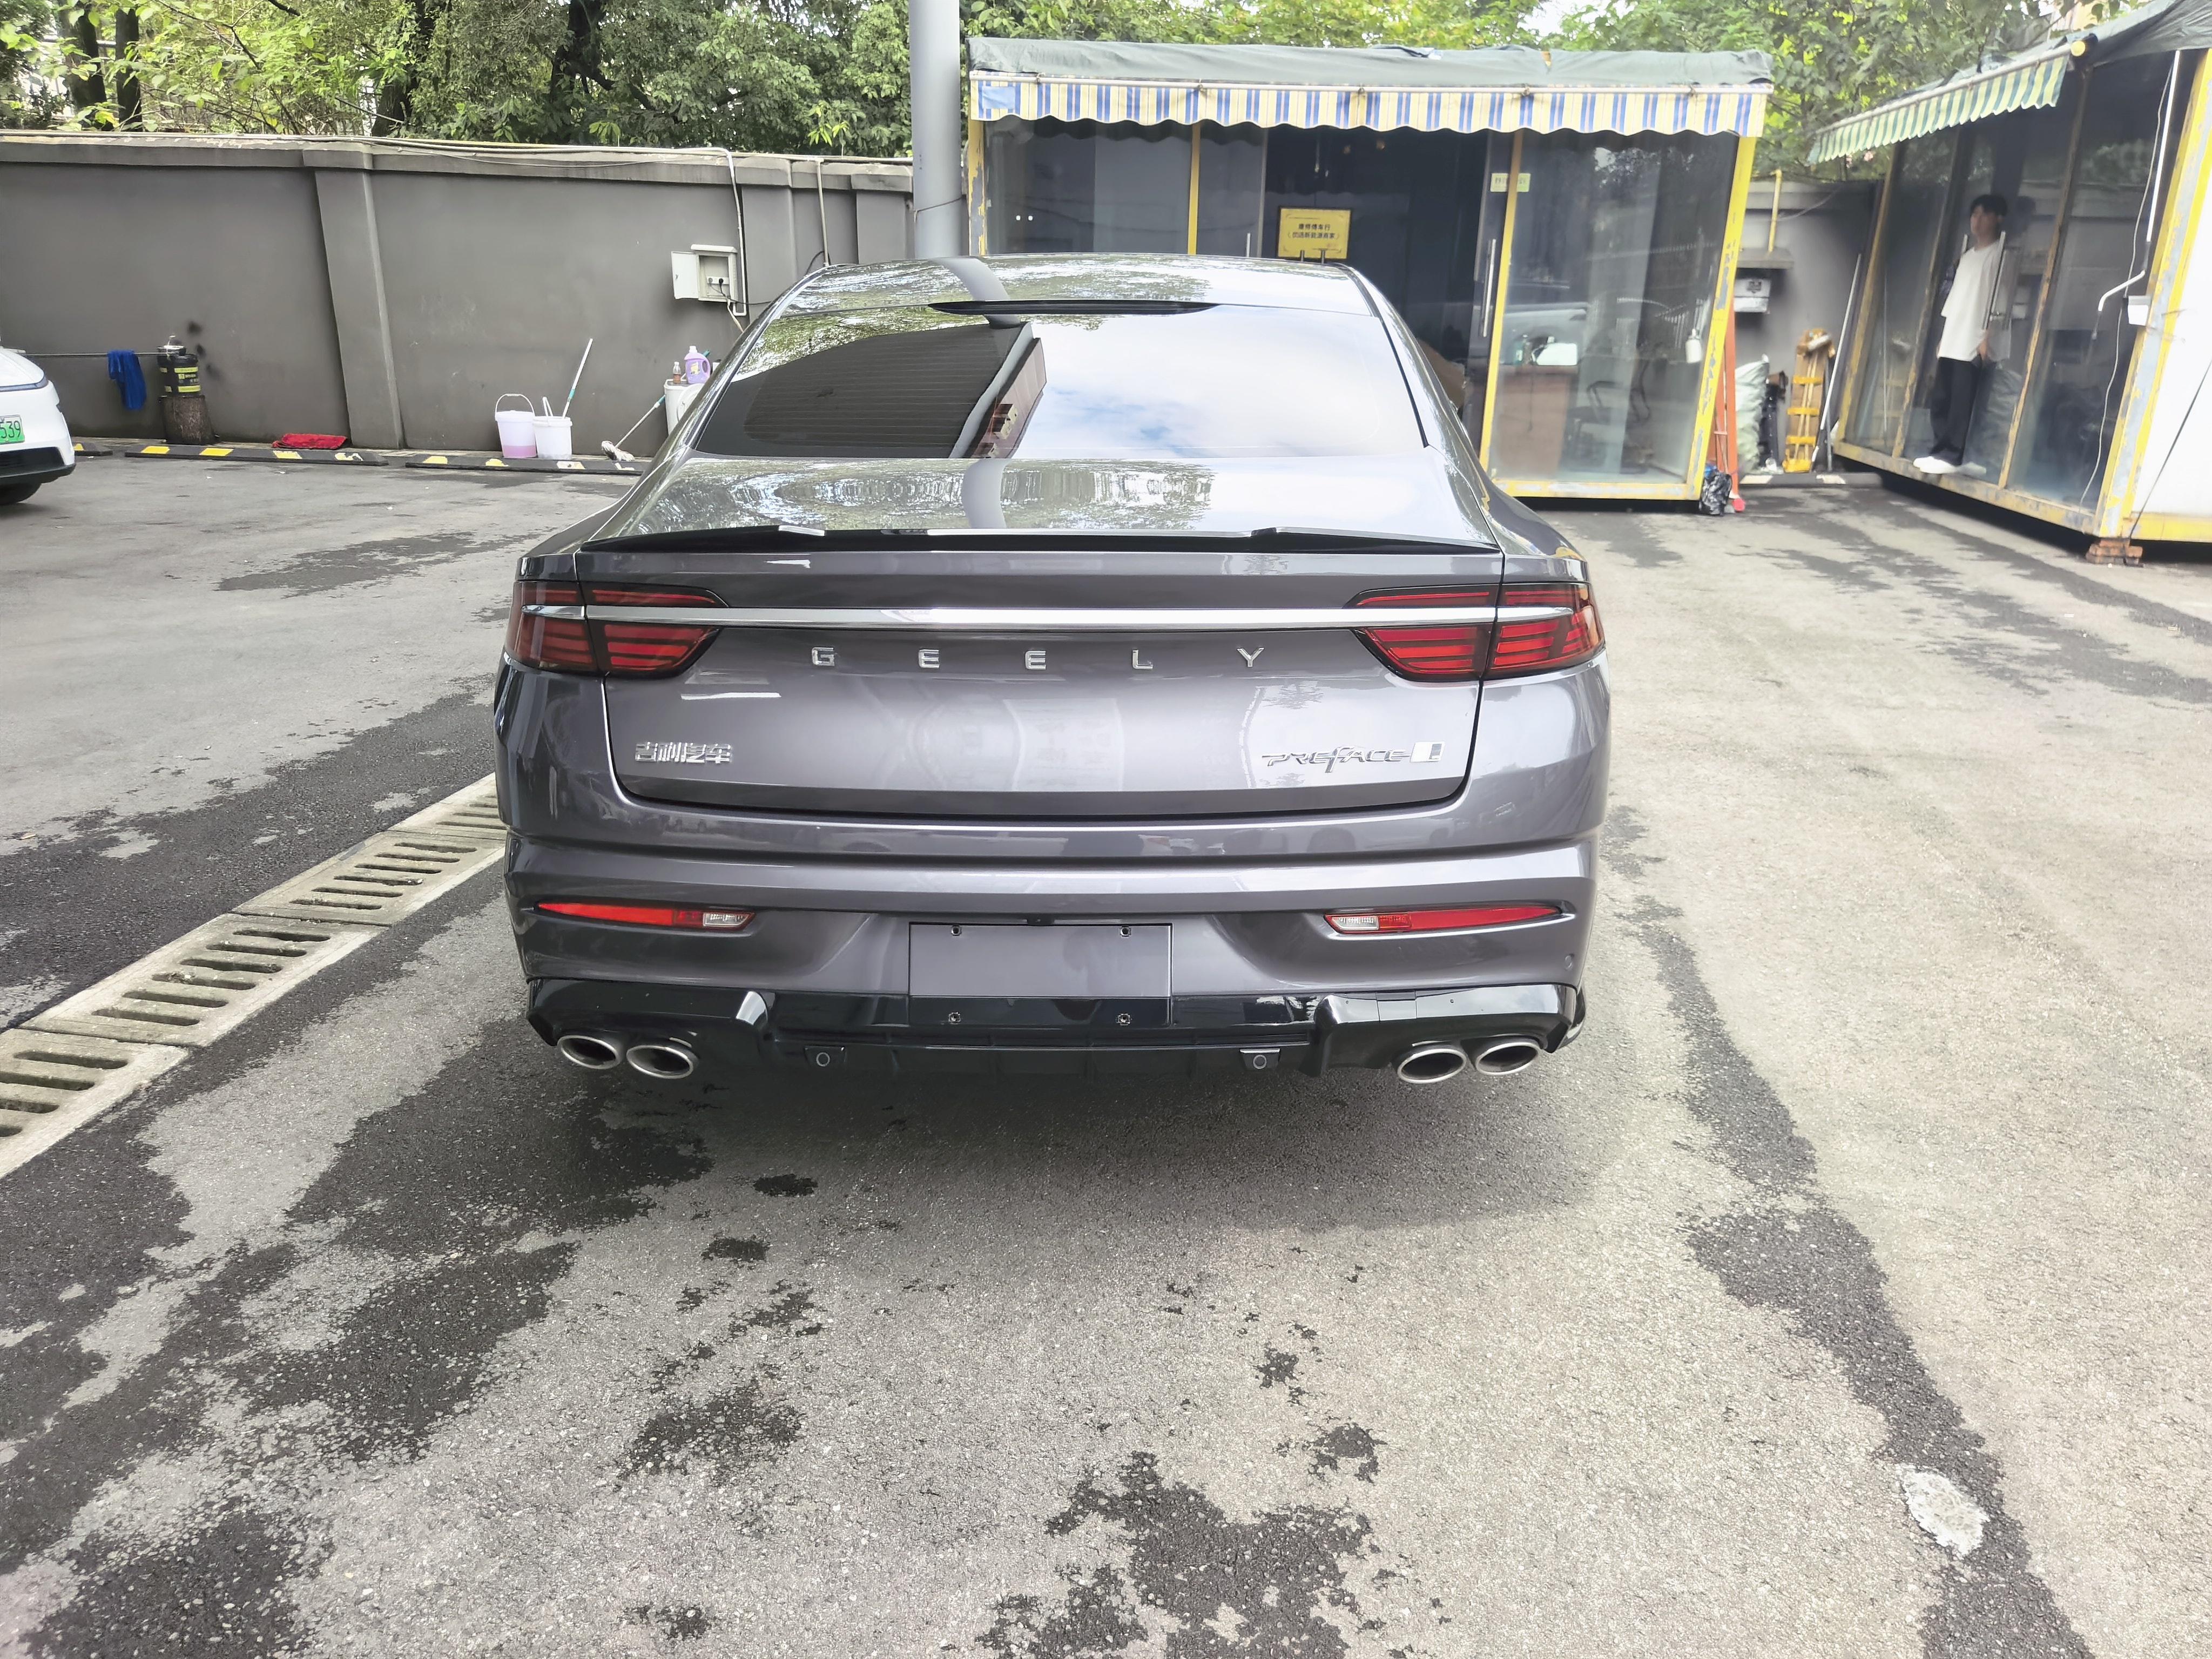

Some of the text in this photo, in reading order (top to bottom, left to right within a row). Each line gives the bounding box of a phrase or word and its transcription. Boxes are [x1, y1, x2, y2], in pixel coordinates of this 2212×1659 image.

[812, 647, 1264, 670] GEELY
[635, 741, 731, 764] 吉利汽车
